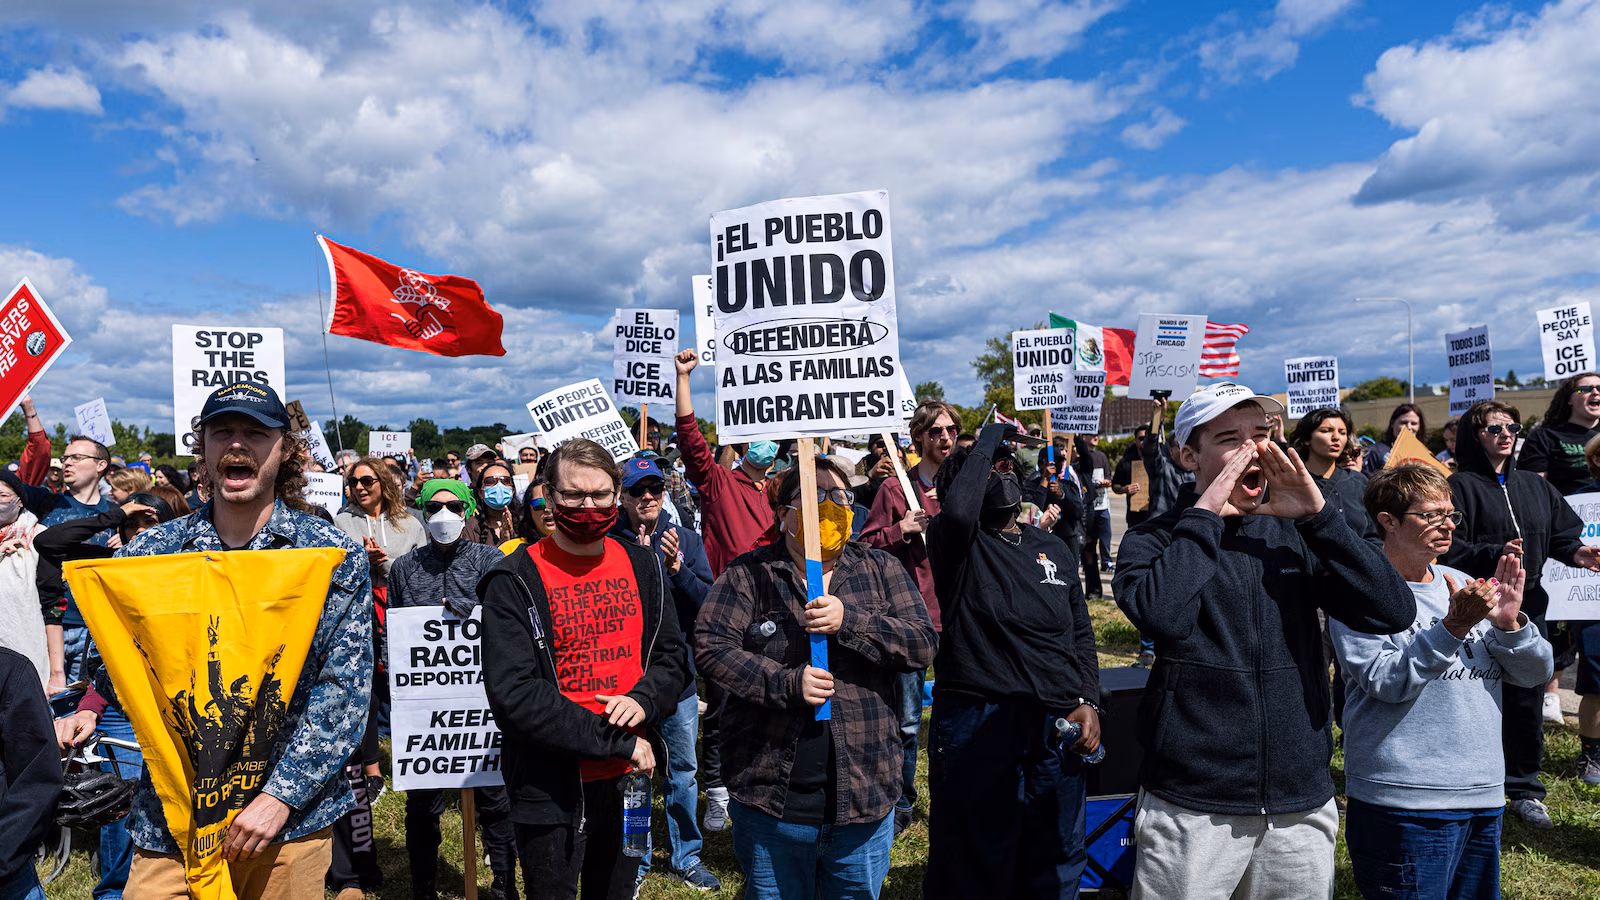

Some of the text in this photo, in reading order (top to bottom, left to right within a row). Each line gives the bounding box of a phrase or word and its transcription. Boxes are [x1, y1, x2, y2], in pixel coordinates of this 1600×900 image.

[717, 208, 883, 262] ¡EL PUEBLO
[716, 249, 886, 314] UNIDO
[635, 312, 654, 325] EL
[1554, 307, 1578, 320] THE
[616, 326, 675, 340] PUEBLO
[1542, 316, 1590, 333] PEOPLE
[195, 330, 264, 349] STOP
[733, 316, 874, 354] DEFENDERÁ
[1016, 334, 1072, 350] ¡EL PUEBLO
[1450, 334, 1486, 352] TODOS LOS
[1556, 328, 1580, 341] SAY
[626, 340, 662, 354] DICE
[1556, 344, 1584, 362] ICE
[204, 350, 256, 368] THE
[1016, 348, 1073, 368] UNIDO
[1137, 352, 1163, 365] STOP
[1286, 360, 1335, 370] THE PEOPLE
[1448, 349, 1490, 368] DERECHOS
[1555, 358, 1588, 375] OUT
[192, 370, 269, 387] RAIDS
[626, 362, 660, 380] ICE
[722, 356, 894, 388] A LAS FAMILIAS
[1028, 370, 1064, 384] JAMÁS
[1145, 364, 1196, 378] FASCISM
[1288, 369, 1335, 384] UNITED
[614, 379, 673, 398] FUERA
[1031, 382, 1057, 396] SERÁ
[1452, 374, 1490, 388] PARA TODOS
[532, 384, 602, 416] THE PEOPLE
[1020, 394, 1067, 408] VENCIDO!
[1074, 386, 1100, 398] IDO
[1290, 395, 1336, 404] IMMIGRANT
[1308, 388, 1338, 396] DEFEND
[1464, 388, 1476, 398] LOS
[538, 396, 610, 432] UNITED
[724, 390, 896, 426] MIGRANTES!
[580, 420, 623, 440] DEFEND
[607, 440, 636, 458] ES!
[574, 580, 602, 596] SAY
[606, 578, 629, 591] NO
[562, 596, 590, 611] THE
[410, 645, 483, 668] RACI
[1434, 662, 1503, 691] not today
[430, 708, 496, 728] KEEP
[398, 754, 502, 776] TOGETH
[346, 764, 372, 853] PLAYBOY
